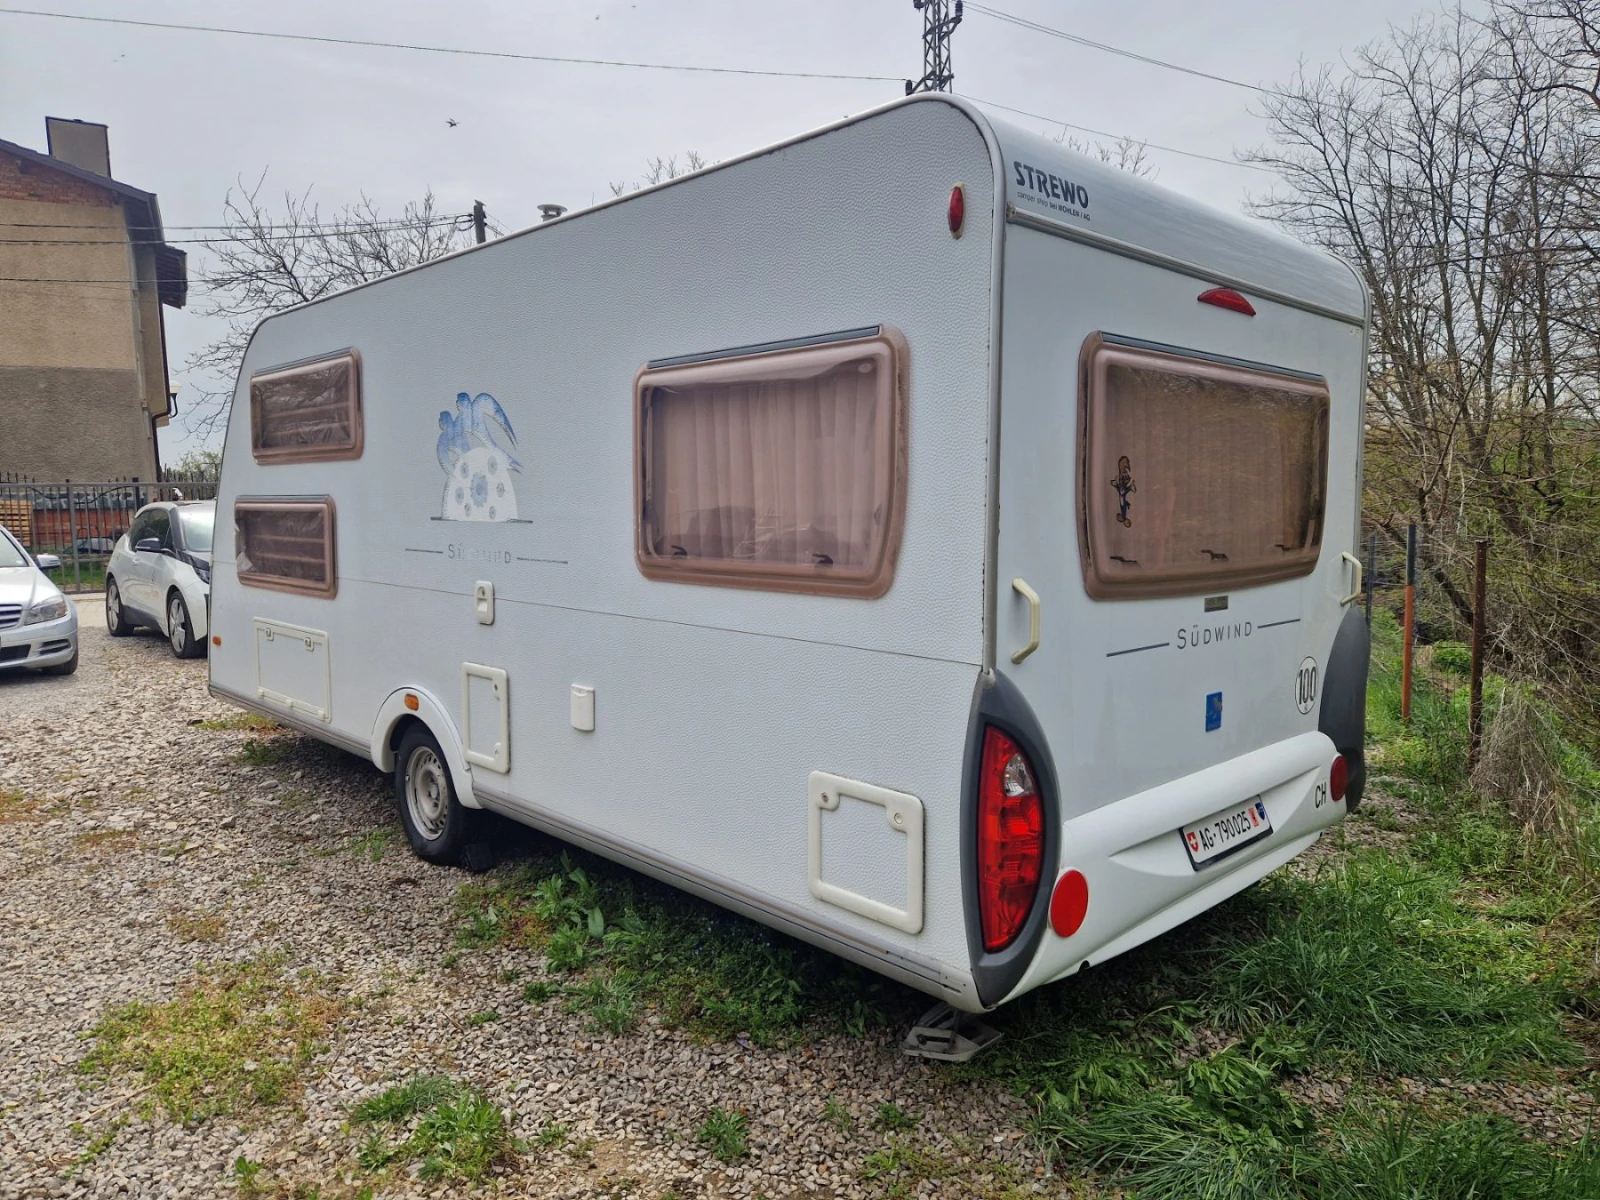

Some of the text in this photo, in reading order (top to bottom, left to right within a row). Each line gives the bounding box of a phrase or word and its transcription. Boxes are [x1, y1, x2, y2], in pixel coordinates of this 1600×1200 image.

[1013, 160, 1089, 209] STREWO
[1177, 621, 1252, 649] SÜDWIND
[1299, 666, 1317, 705] 100
[1314, 781, 1327, 809] CH
